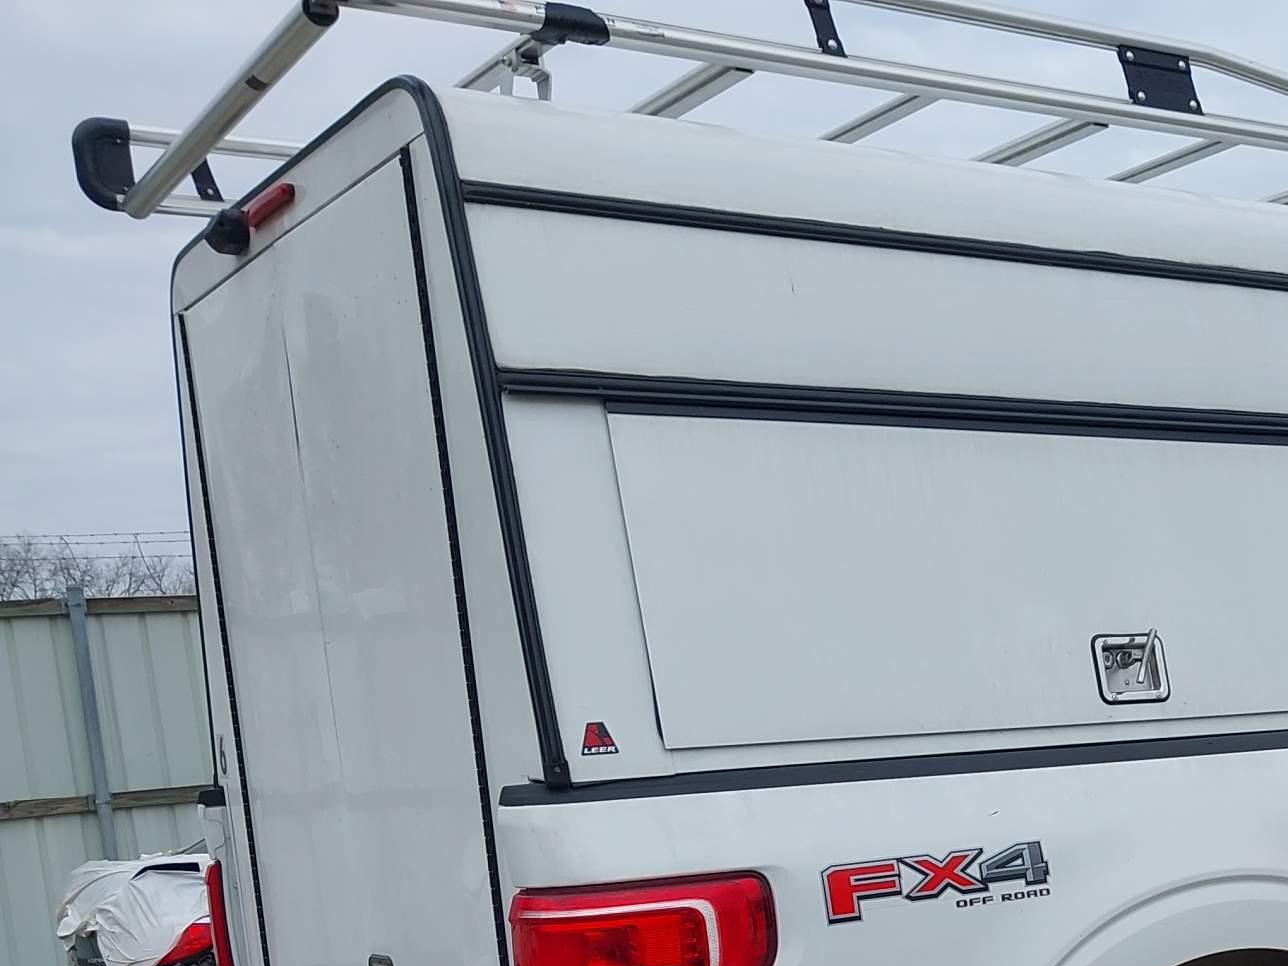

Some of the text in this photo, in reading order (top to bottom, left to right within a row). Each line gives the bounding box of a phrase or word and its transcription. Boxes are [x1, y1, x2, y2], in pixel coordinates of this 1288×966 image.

[583, 745, 617, 754] LEER
[821, 840, 1050, 925] FX4
[955, 887, 1051, 908] OFF ROAD
